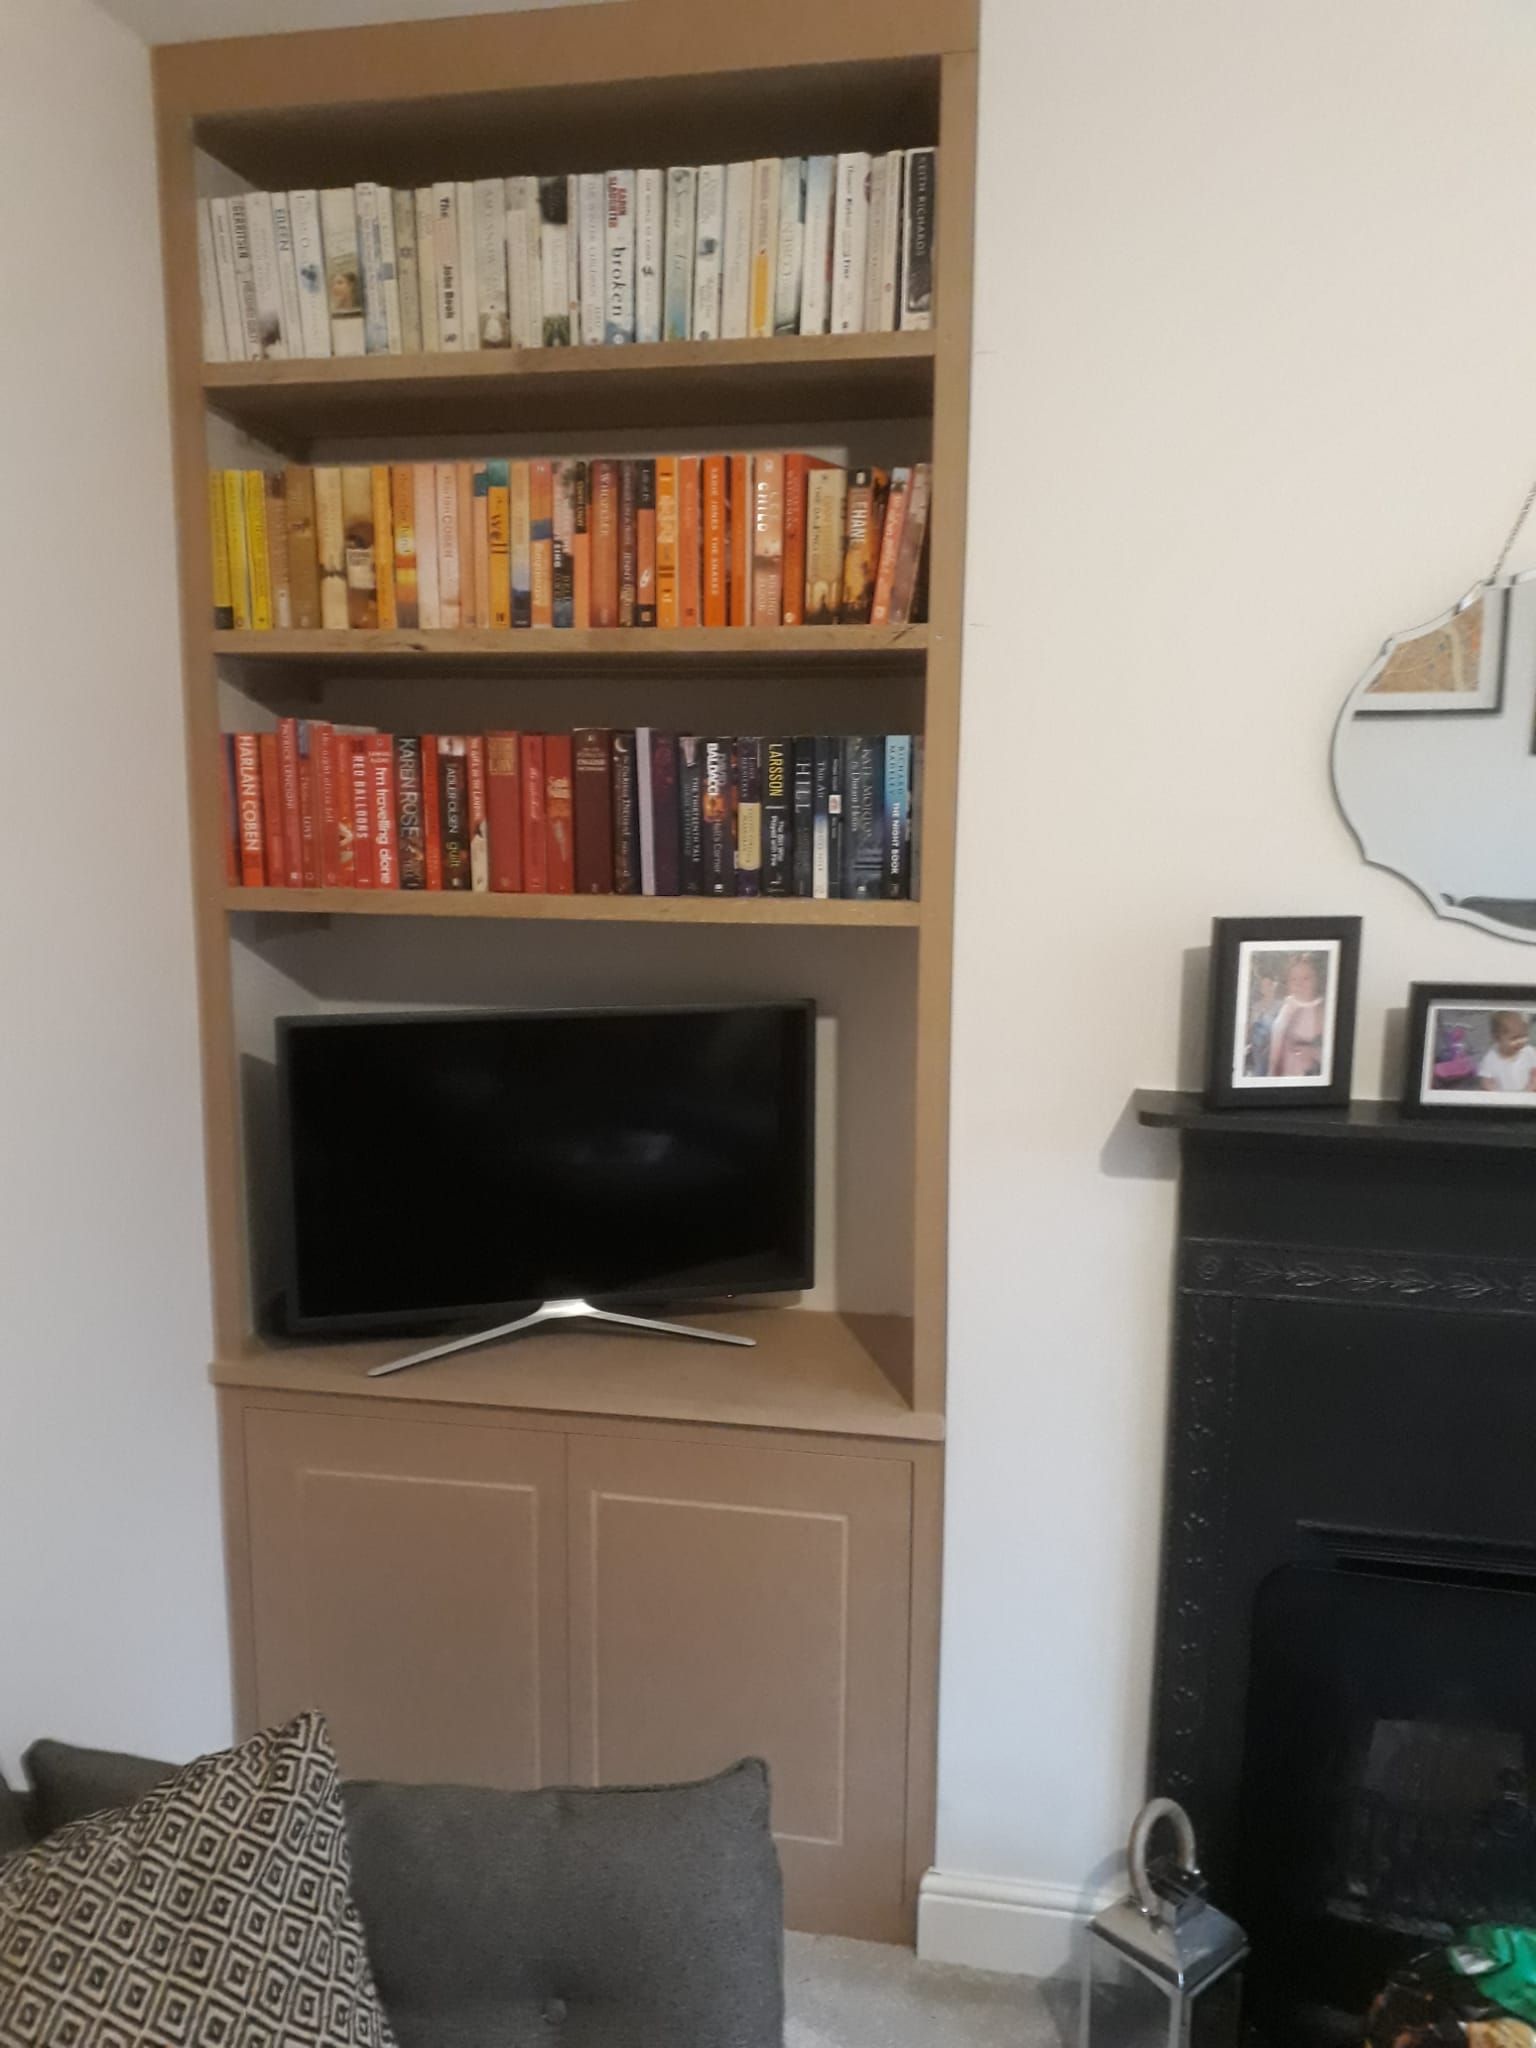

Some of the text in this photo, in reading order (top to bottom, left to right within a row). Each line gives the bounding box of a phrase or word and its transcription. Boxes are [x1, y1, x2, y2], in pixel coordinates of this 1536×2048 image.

[440, 197, 450, 219] The
[608, 176, 617, 228] SLAUGHTER
[915, 156, 928, 257] KEITH RICHARDS
[233, 205, 249, 259] GERRITSEN
[275, 208, 290, 252] EILEEN
[612, 247, 627, 316] broken
[711, 501, 719, 531] JONES
[757, 482, 768, 533] CHILD
[491, 514, 508, 555] well
[711, 537, 719, 554] THE
[281, 724, 290, 761] PATRICK
[318, 750, 330, 774] night
[239, 735, 260, 851] HARLAN COBEN
[399, 738, 419, 836] KAREN ROSE
[707, 742, 718, 796] BALDACCI
[768, 743, 784, 797] LARSSON
[796, 762, 811, 814] HILL
[817, 761, 826, 799] Thin Air
[851, 772, 861, 803] Distant
[862, 749, 873, 841] KATE MORTON
[352, 756, 368, 839] RED BALLOONS
[375, 789, 391, 845] travelling
[446, 767, 461, 868] ADLER OLSEN guilt
[692, 777, 700, 863] THE THIRTEENTH TALE
[851, 805, 861, 833] Hours
[713, 843, 723, 873] Corner
[770, 853, 778, 867] Fire
[890, 802, 901, 875] THE NIGHT BOOK
[379, 848, 392, 884] alone
